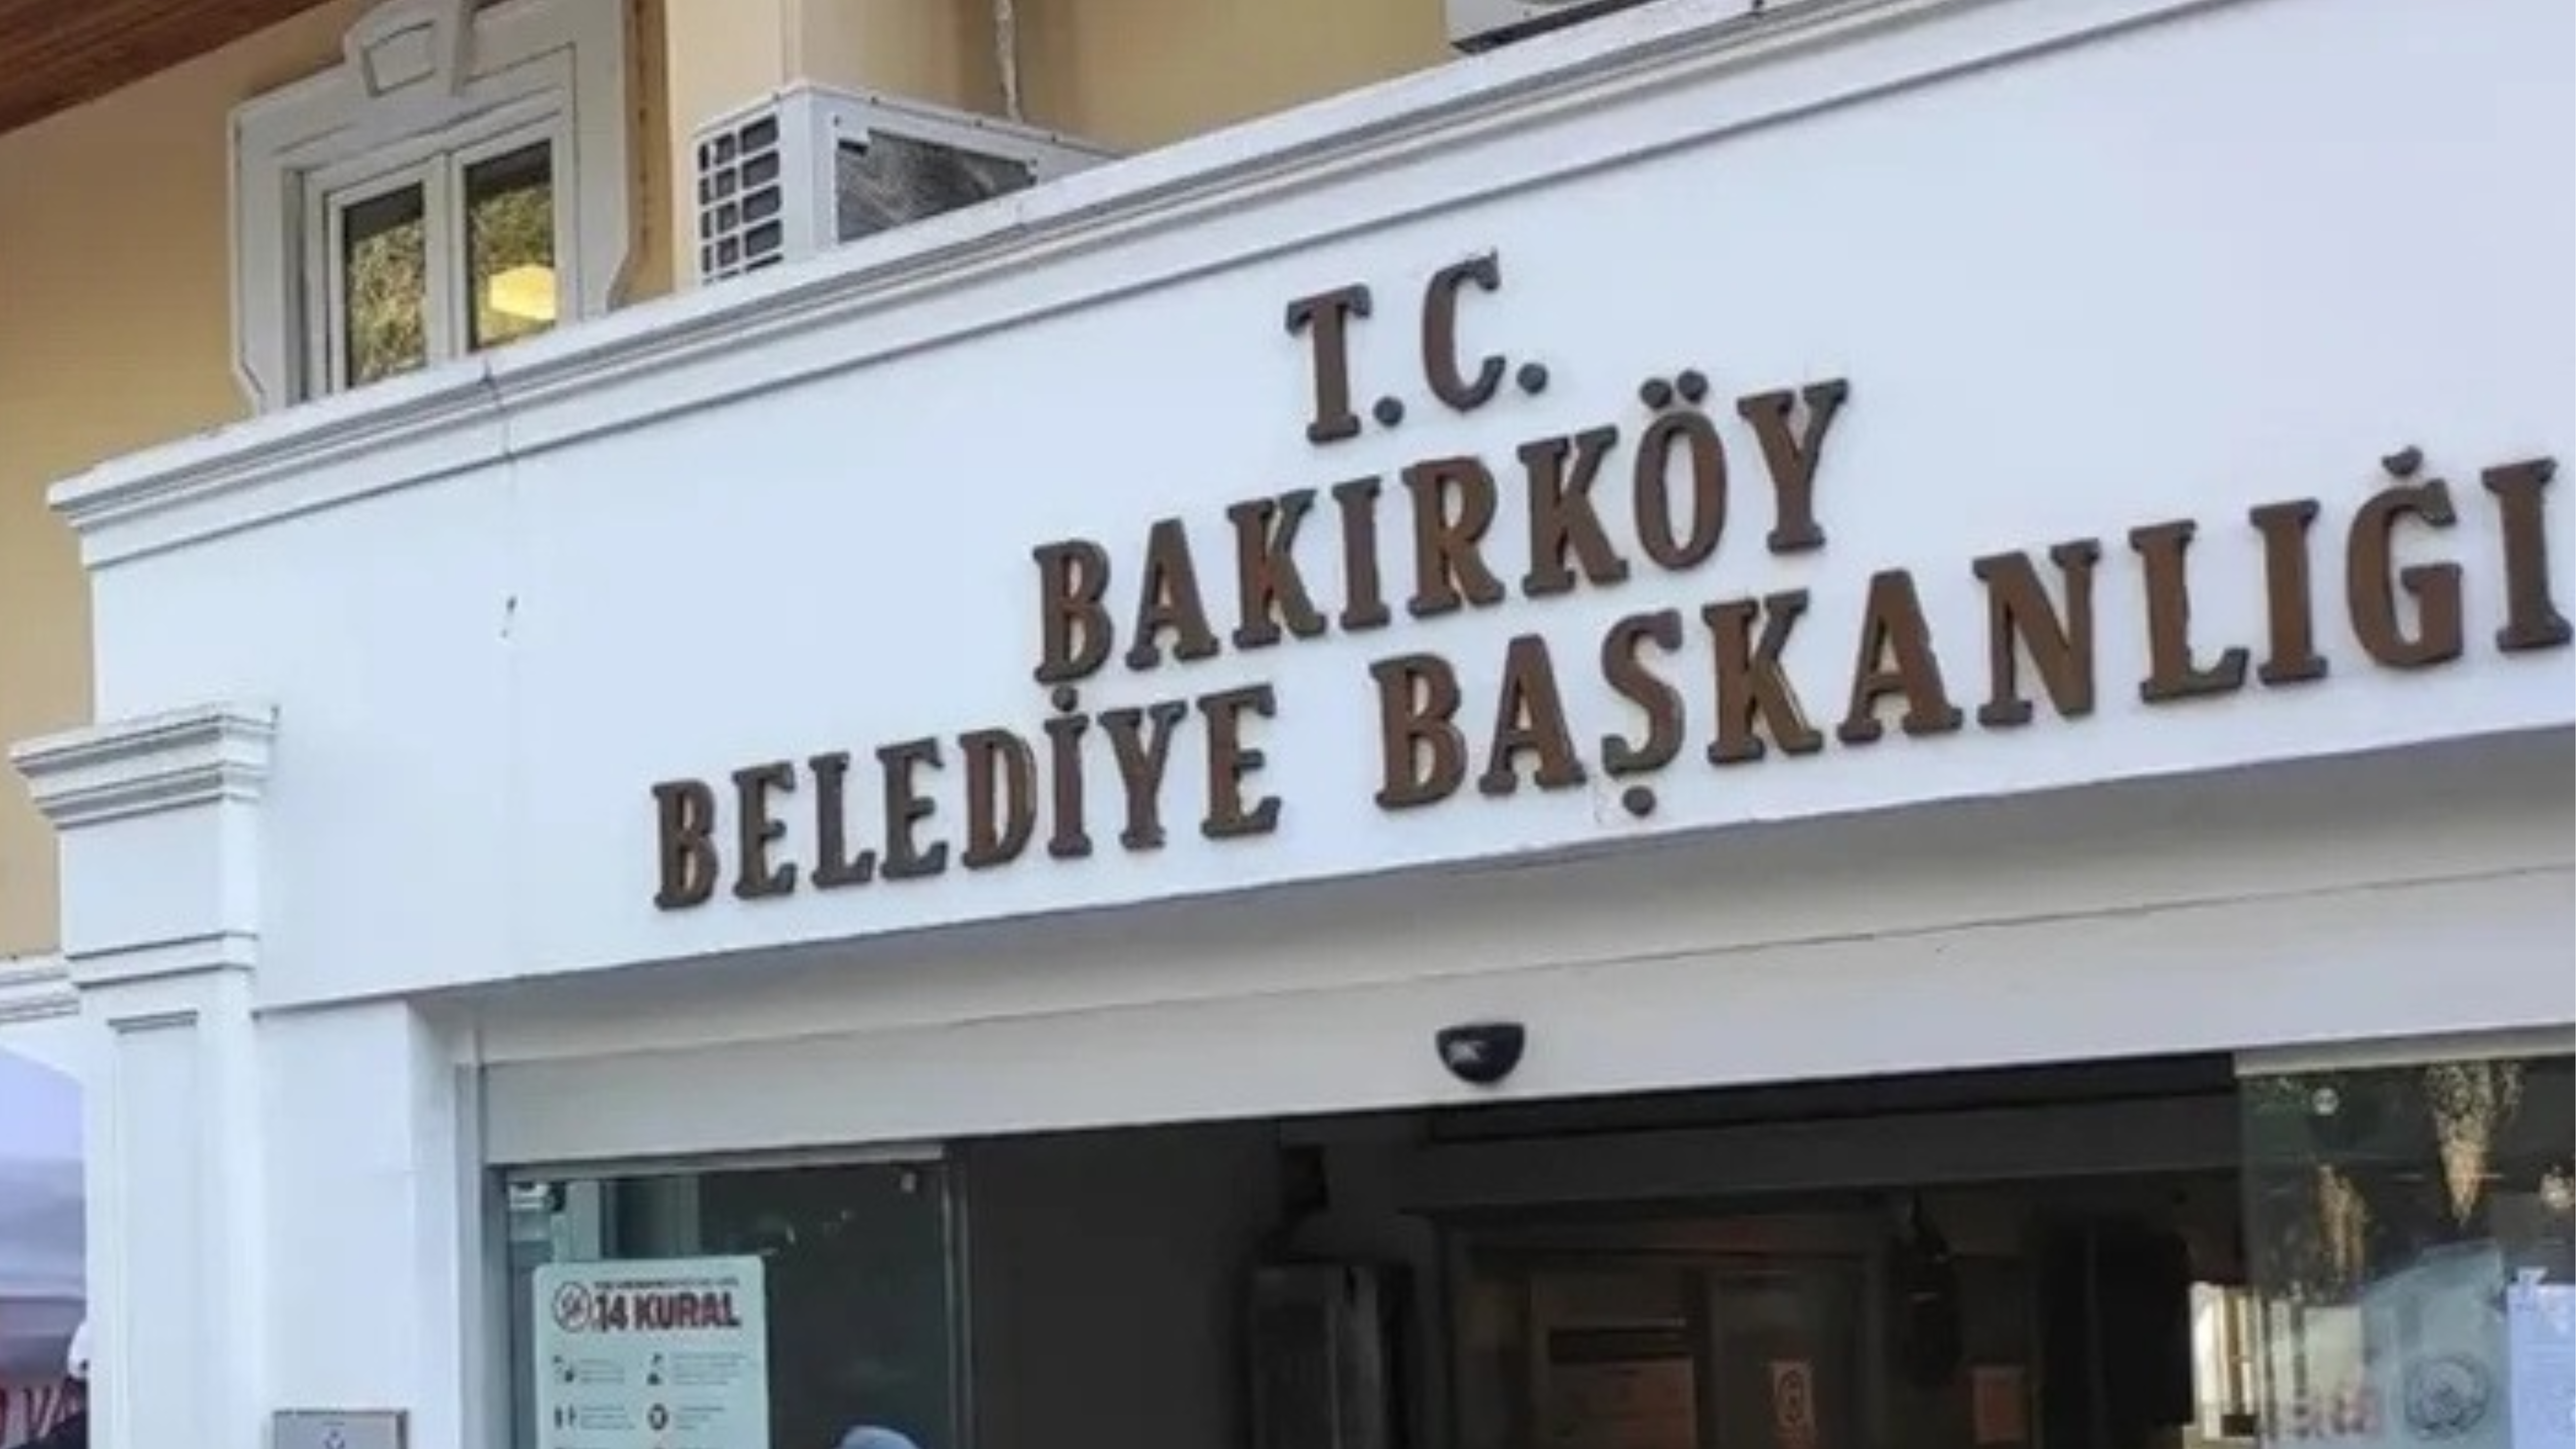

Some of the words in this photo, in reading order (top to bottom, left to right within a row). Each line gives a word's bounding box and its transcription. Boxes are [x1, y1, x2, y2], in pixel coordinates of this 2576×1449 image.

[1286, 251, 1549, 444] T.C.
[1032, 371, 1849, 686] BAKIRKÖY
[651, 685, 1281, 911] BELEDİYE
[1371, 446, 2573, 816] BAŞKANLIĞI
[595, 1292, 628, 1332] 14
[634, 1291, 742, 1330] KURAL
